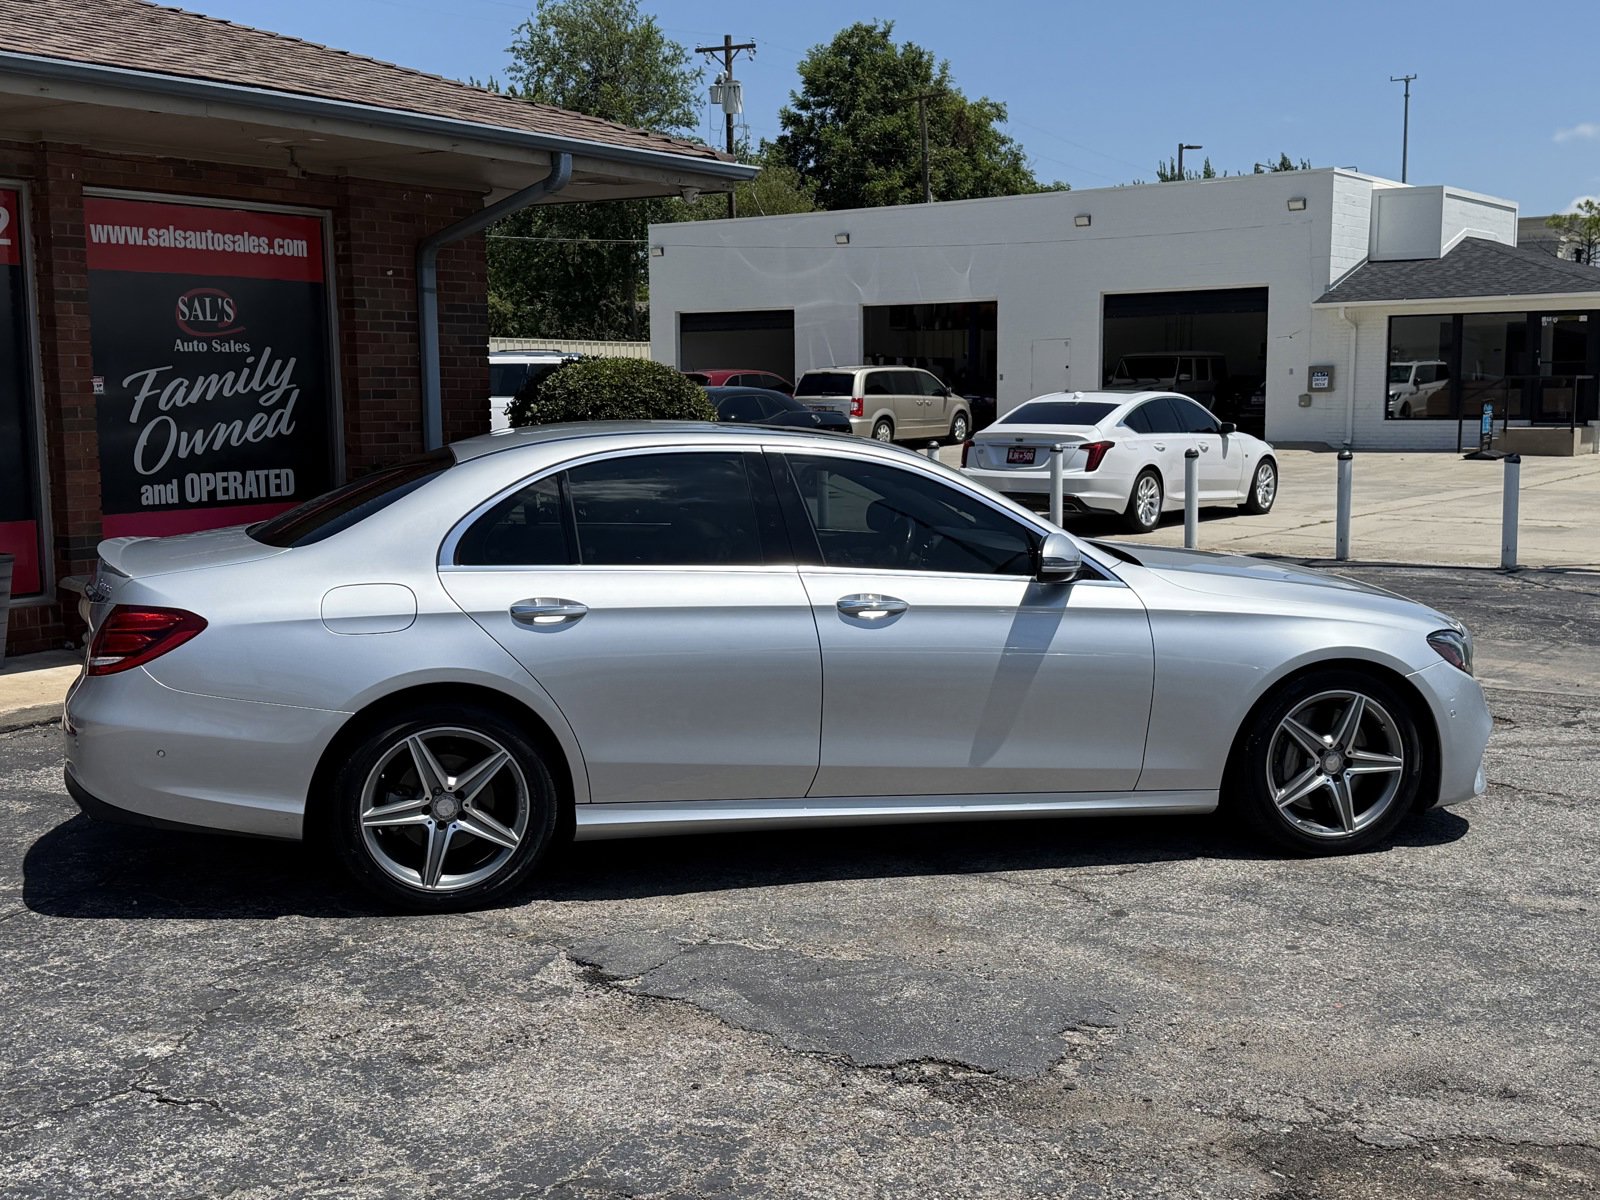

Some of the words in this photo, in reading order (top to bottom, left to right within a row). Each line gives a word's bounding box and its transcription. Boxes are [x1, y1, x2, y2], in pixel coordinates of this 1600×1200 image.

[89, 223, 308, 258] www.salsautosales.com
[177, 296, 235, 323] SAL'S
[174, 339, 208, 352] Auto
[211, 339, 251, 353] Sales
[122, 346, 297, 424] Family
[133, 388, 300, 475] Owned
[140, 479, 179, 506] and
[184, 468, 295, 503] OPERATED
